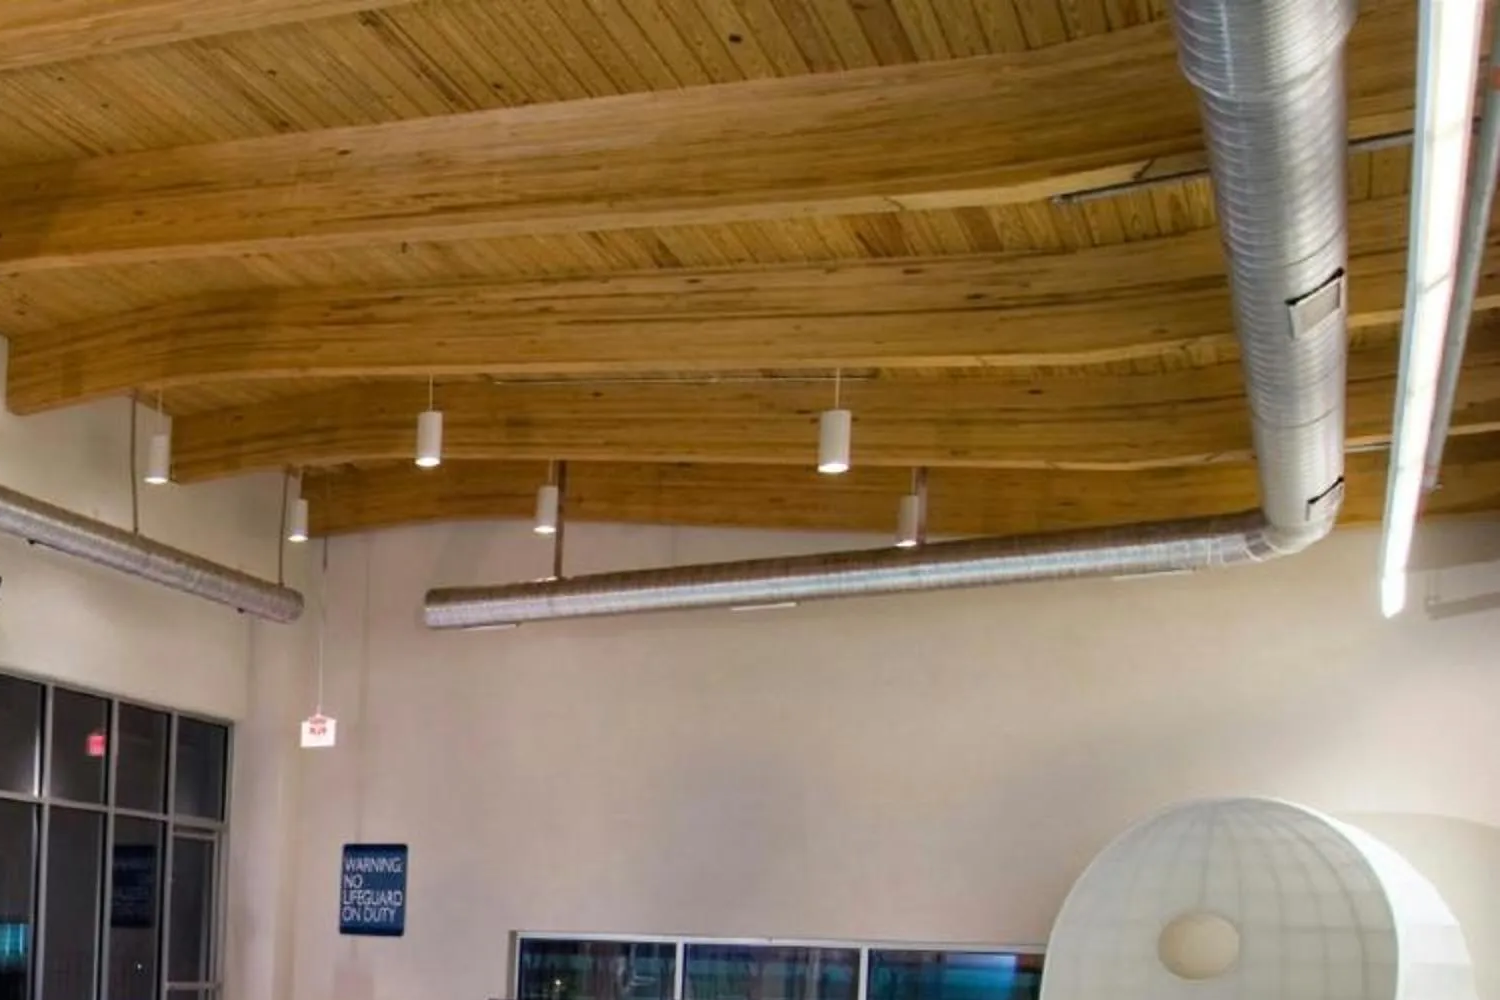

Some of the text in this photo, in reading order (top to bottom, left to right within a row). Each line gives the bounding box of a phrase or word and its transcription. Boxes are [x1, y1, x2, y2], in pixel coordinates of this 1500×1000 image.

[343, 874, 363, 889] NO
[342, 905, 397, 923] ON DUTY
